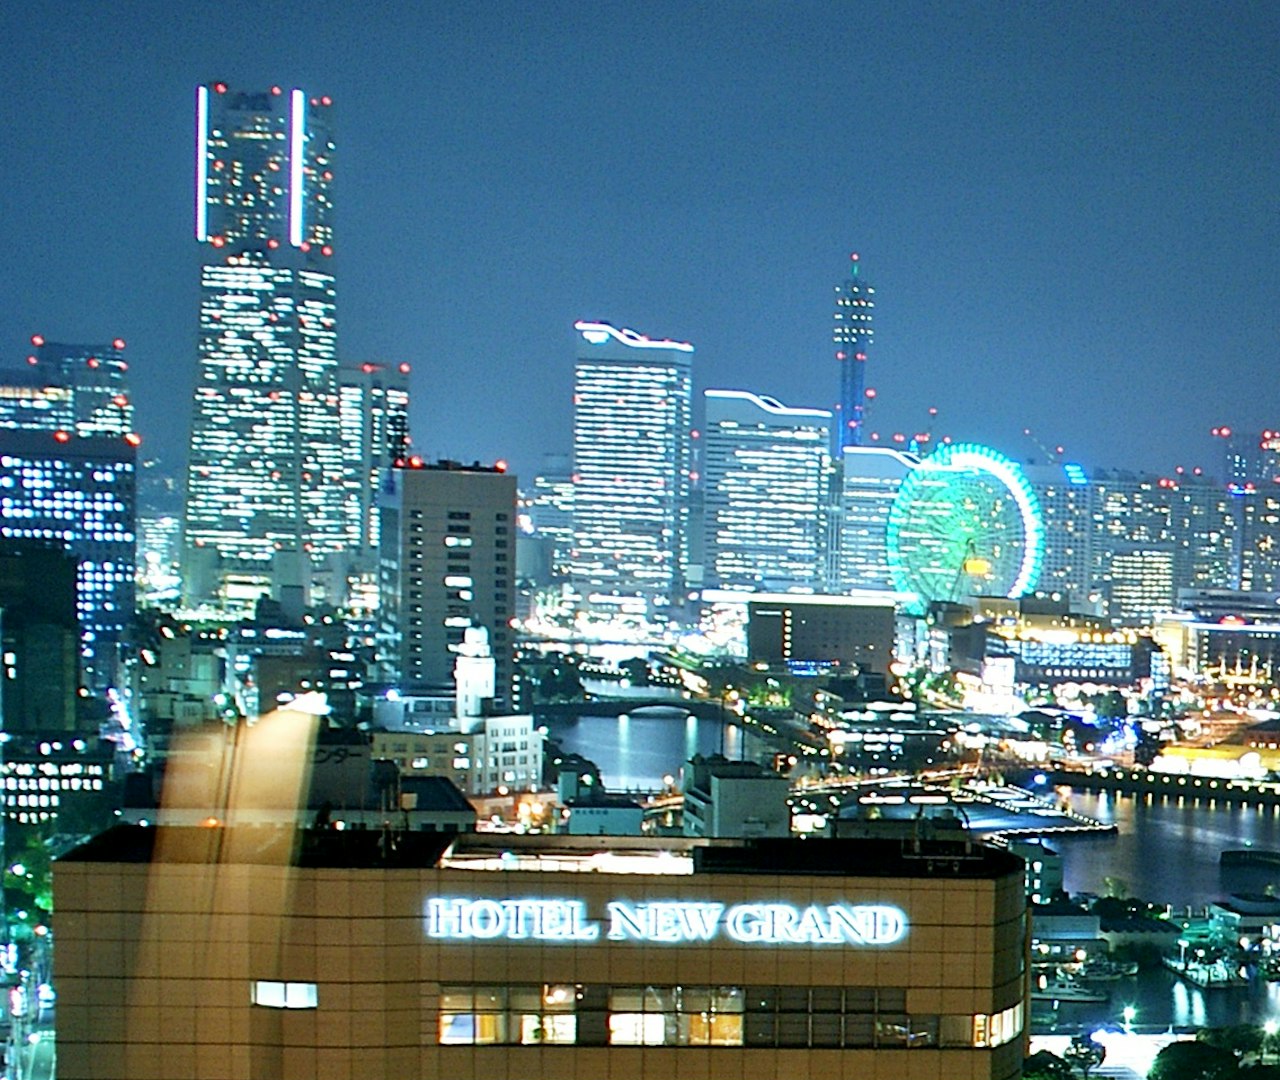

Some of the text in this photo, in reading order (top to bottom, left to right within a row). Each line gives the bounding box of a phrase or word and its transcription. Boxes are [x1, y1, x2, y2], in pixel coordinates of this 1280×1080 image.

[427, 897, 907, 944] HOTEL NEW GRAND
